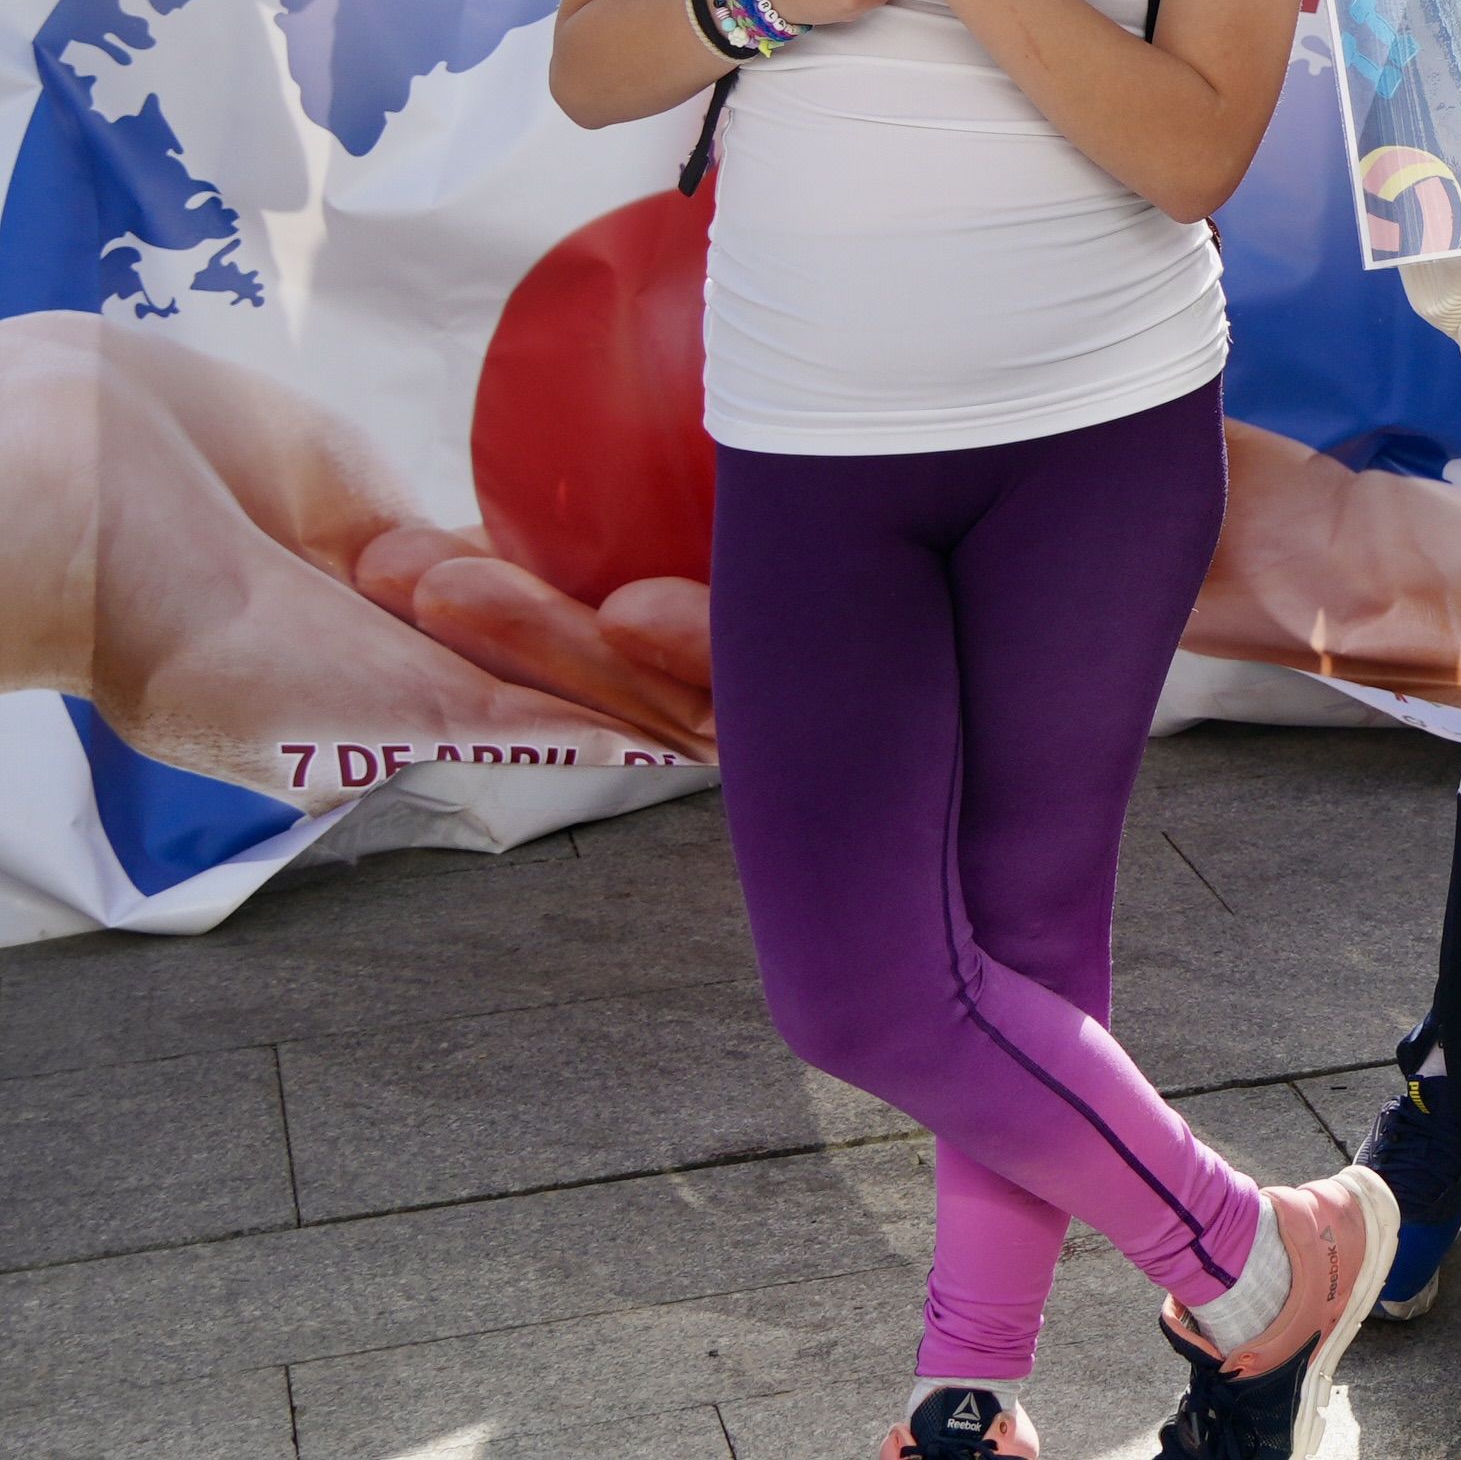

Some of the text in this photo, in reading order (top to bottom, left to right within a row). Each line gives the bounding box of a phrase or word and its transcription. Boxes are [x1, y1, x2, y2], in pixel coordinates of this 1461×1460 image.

[280, 744, 317, 788] 7
[1326, 1244, 1339, 1302] Reebok
[946, 1418, 982, 1432] Reebok
